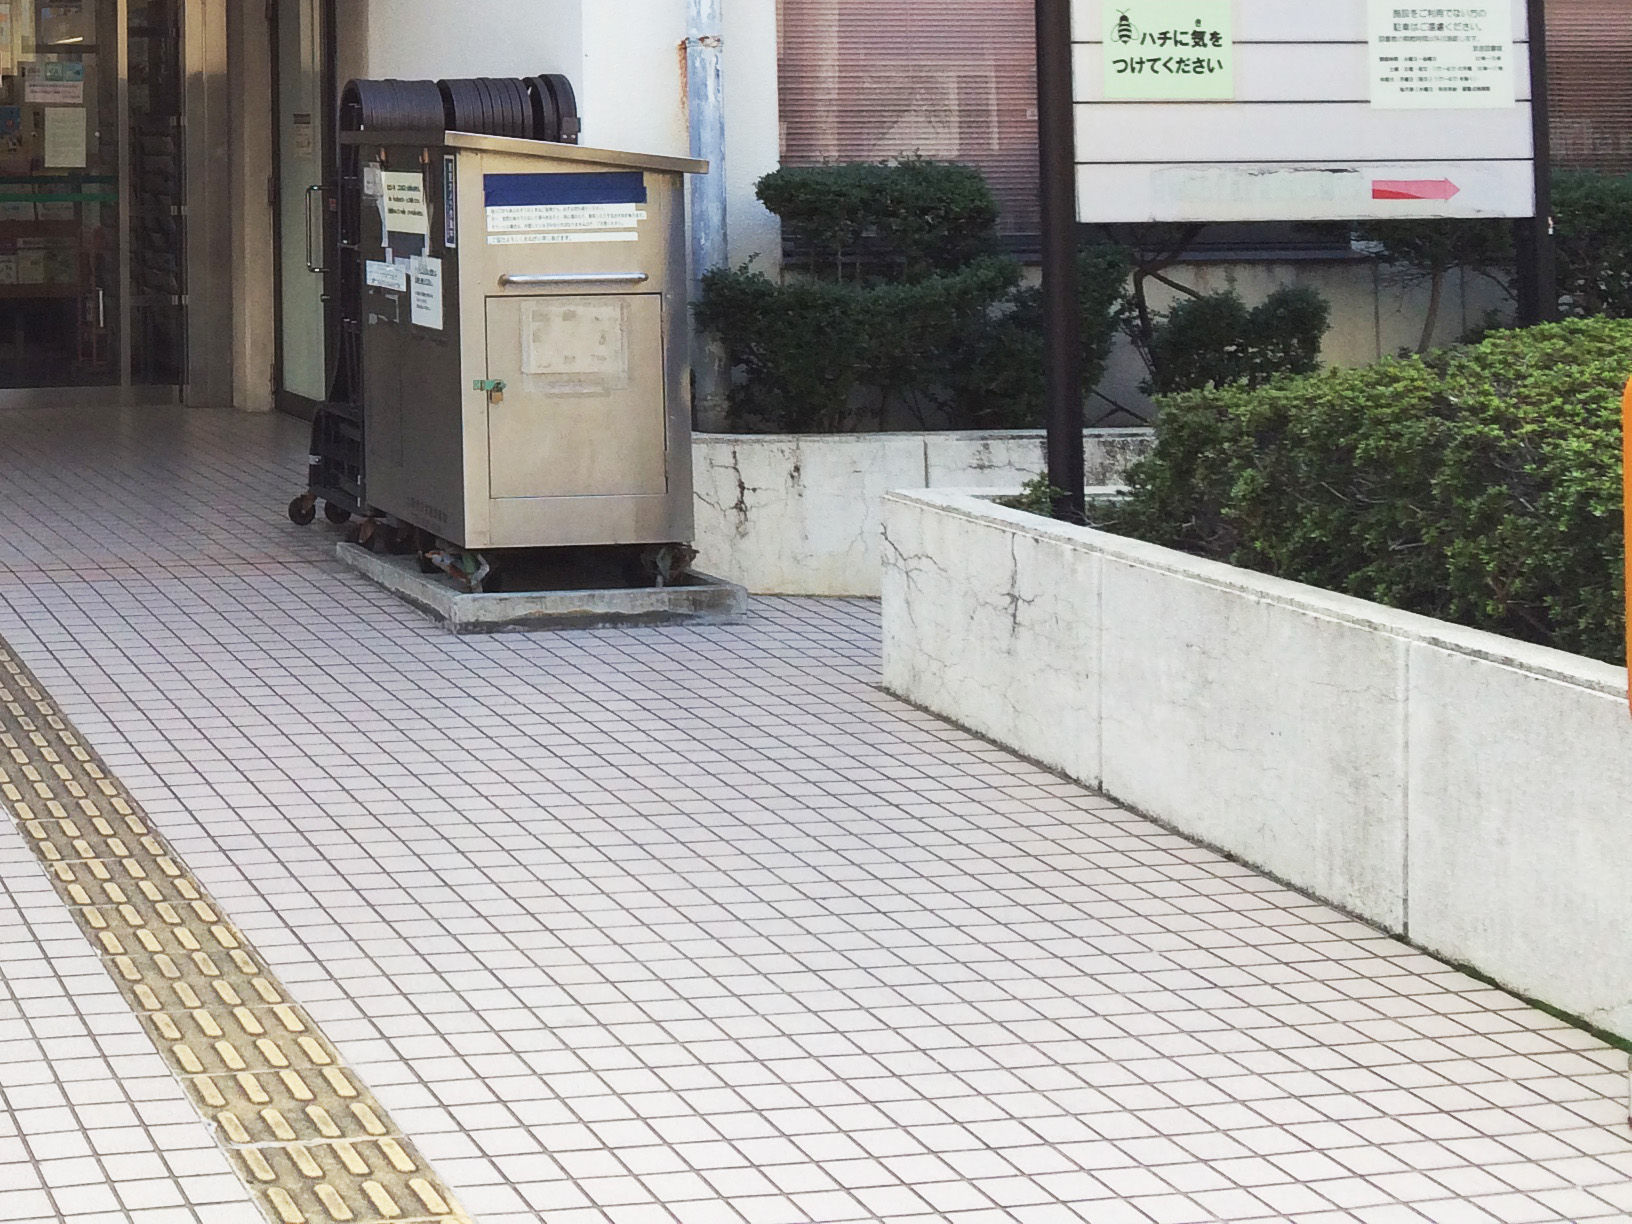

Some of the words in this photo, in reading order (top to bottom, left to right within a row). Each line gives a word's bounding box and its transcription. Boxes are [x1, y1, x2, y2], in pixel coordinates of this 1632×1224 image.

[1139, 29, 1223, 48] ハチに気を
[1112, 56, 1223, 74] つけてください
